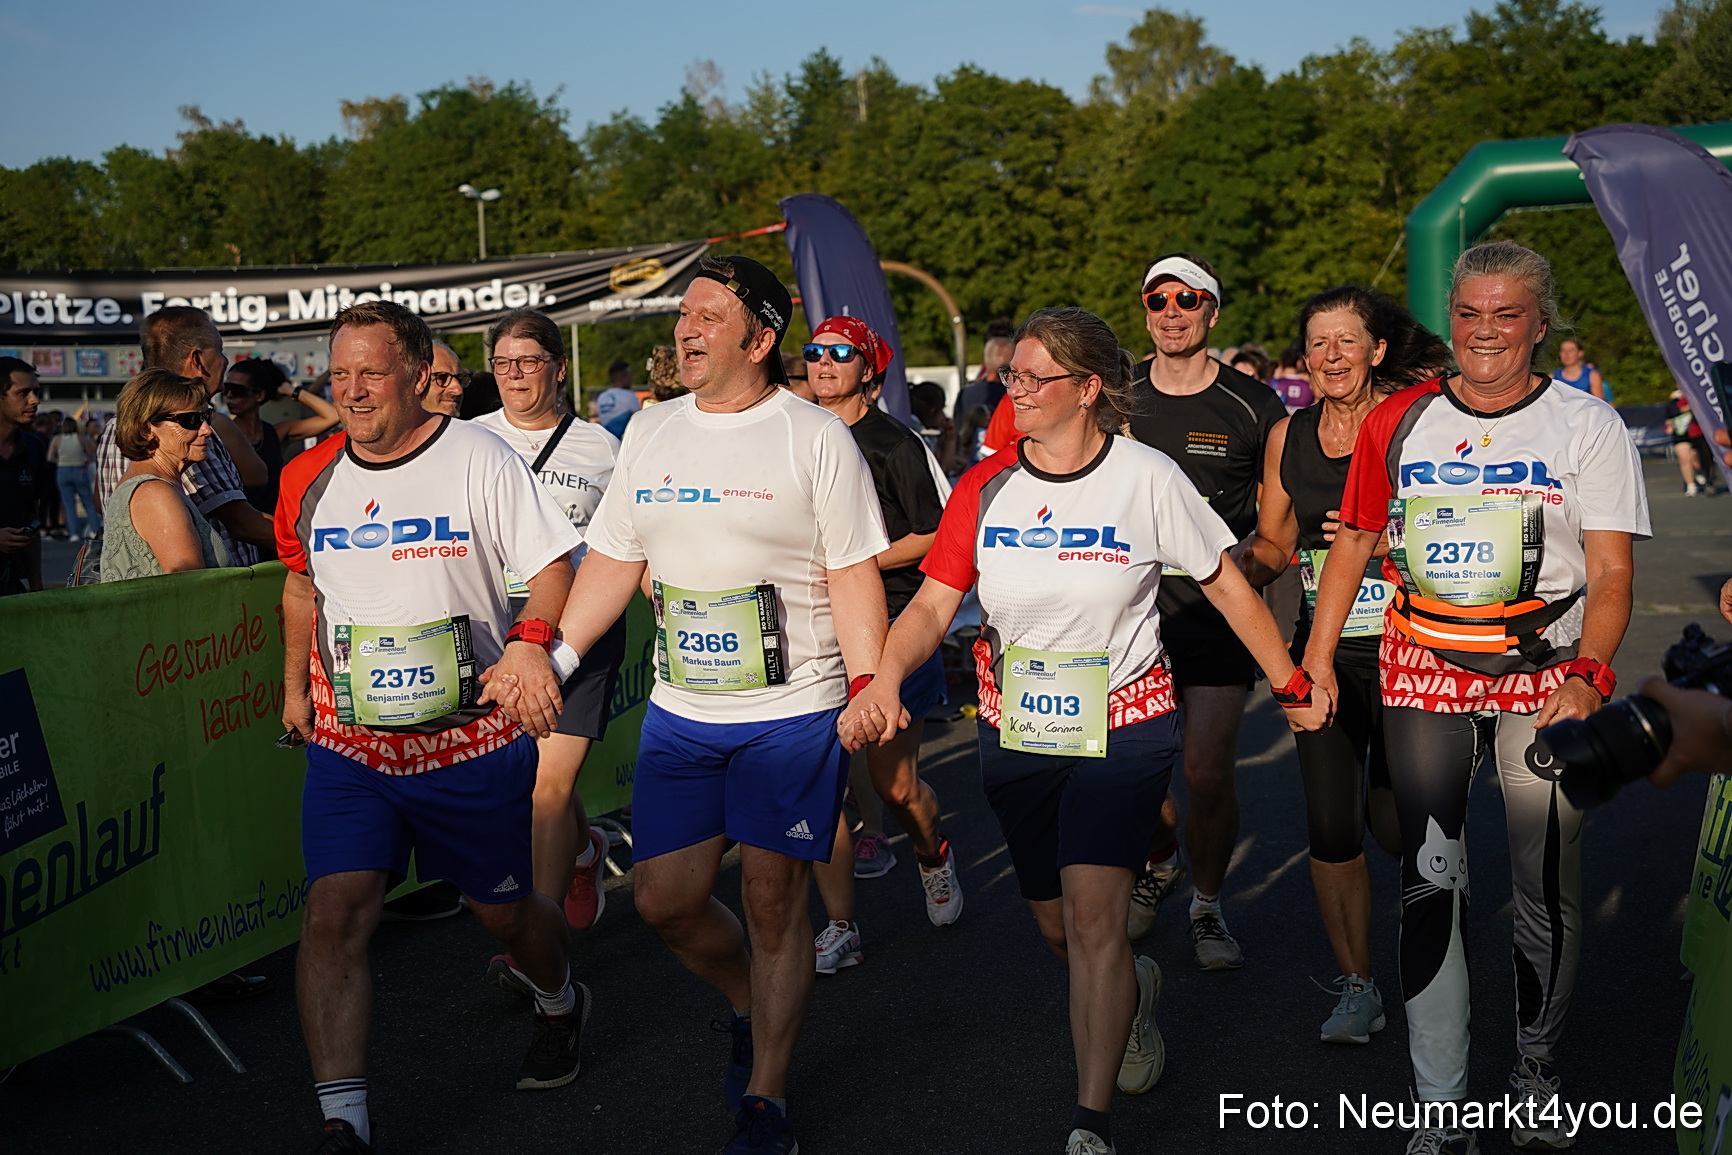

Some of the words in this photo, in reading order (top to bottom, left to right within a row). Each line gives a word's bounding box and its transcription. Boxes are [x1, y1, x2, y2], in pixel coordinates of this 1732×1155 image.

[1432, 517, 1466, 526] Firmenlauf
[1426, 541, 1495, 565] 2378
[1425, 570, 1460, 579] Monika
[1462, 569, 1501, 579] Strelow
[1355, 606, 1383, 615] Weizer
[374, 645, 407, 654] Firmenlauf
[677, 630, 739, 653] 2366
[682, 655, 713, 666] Markus
[714, 658, 741, 667] Baum
[767, 651, 777, 680] HILTL
[370, 665, 436, 689] 2375
[1393, 671, 1458, 698] AVIA
[1465, 673, 1534, 699] AVIA
[366, 692, 411, 703] Benjamin
[411, 686, 446, 700] Schmid
[1020, 692, 1080, 716] 4013
[1044, 722, 1083, 733] Corinna
[403, 727, 472, 760] AVIA
[786, 830, 814, 841] adidas
[0, 761, 165, 935] enlauf
[493, 882, 519, 894] adidas
